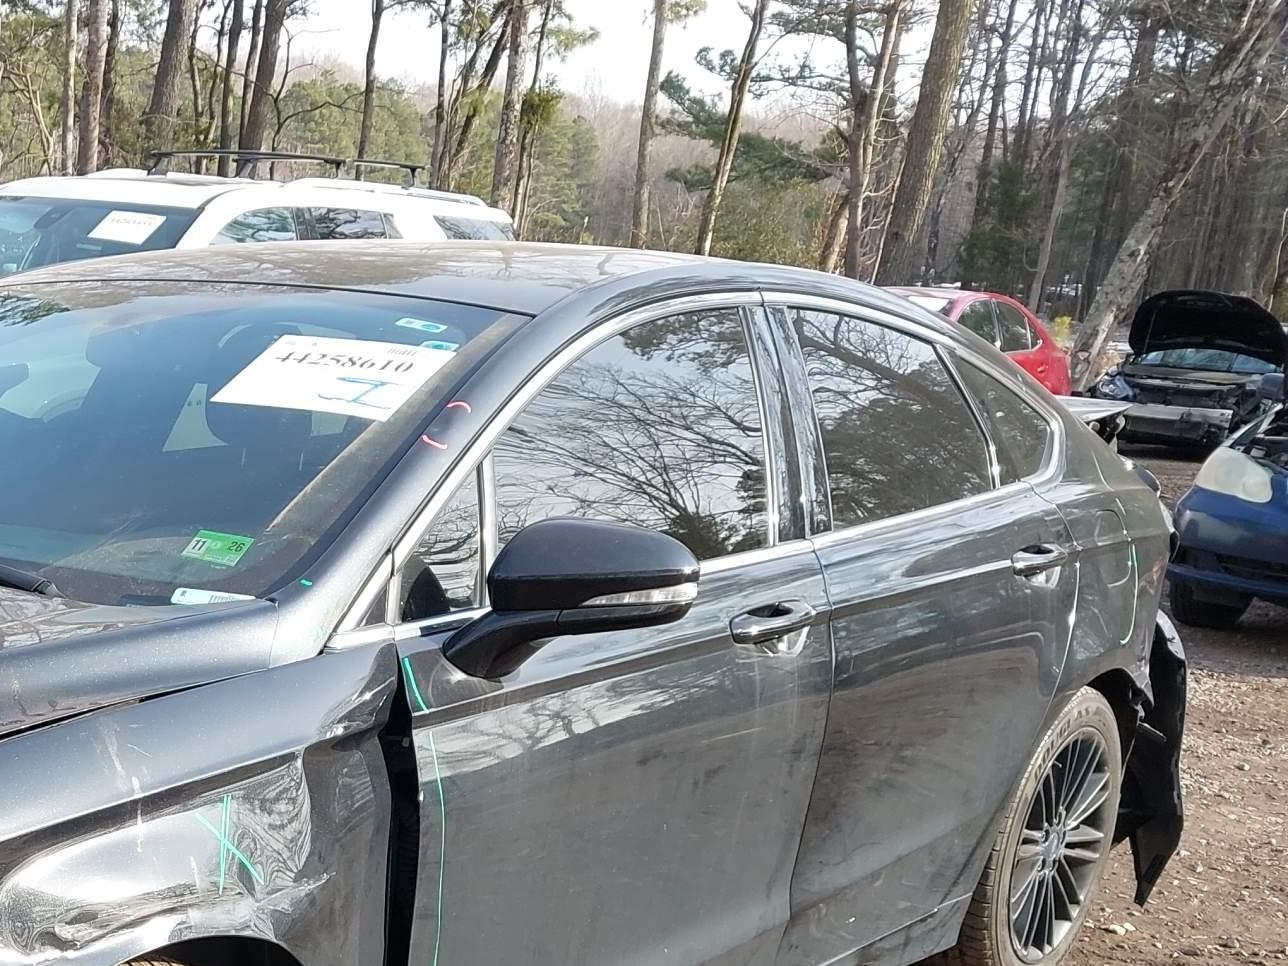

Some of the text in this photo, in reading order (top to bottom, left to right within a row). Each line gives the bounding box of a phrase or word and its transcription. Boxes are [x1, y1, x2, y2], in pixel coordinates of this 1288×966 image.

[275, 351, 414, 373] 44258610
[192, 539, 246, 552] 11 26
